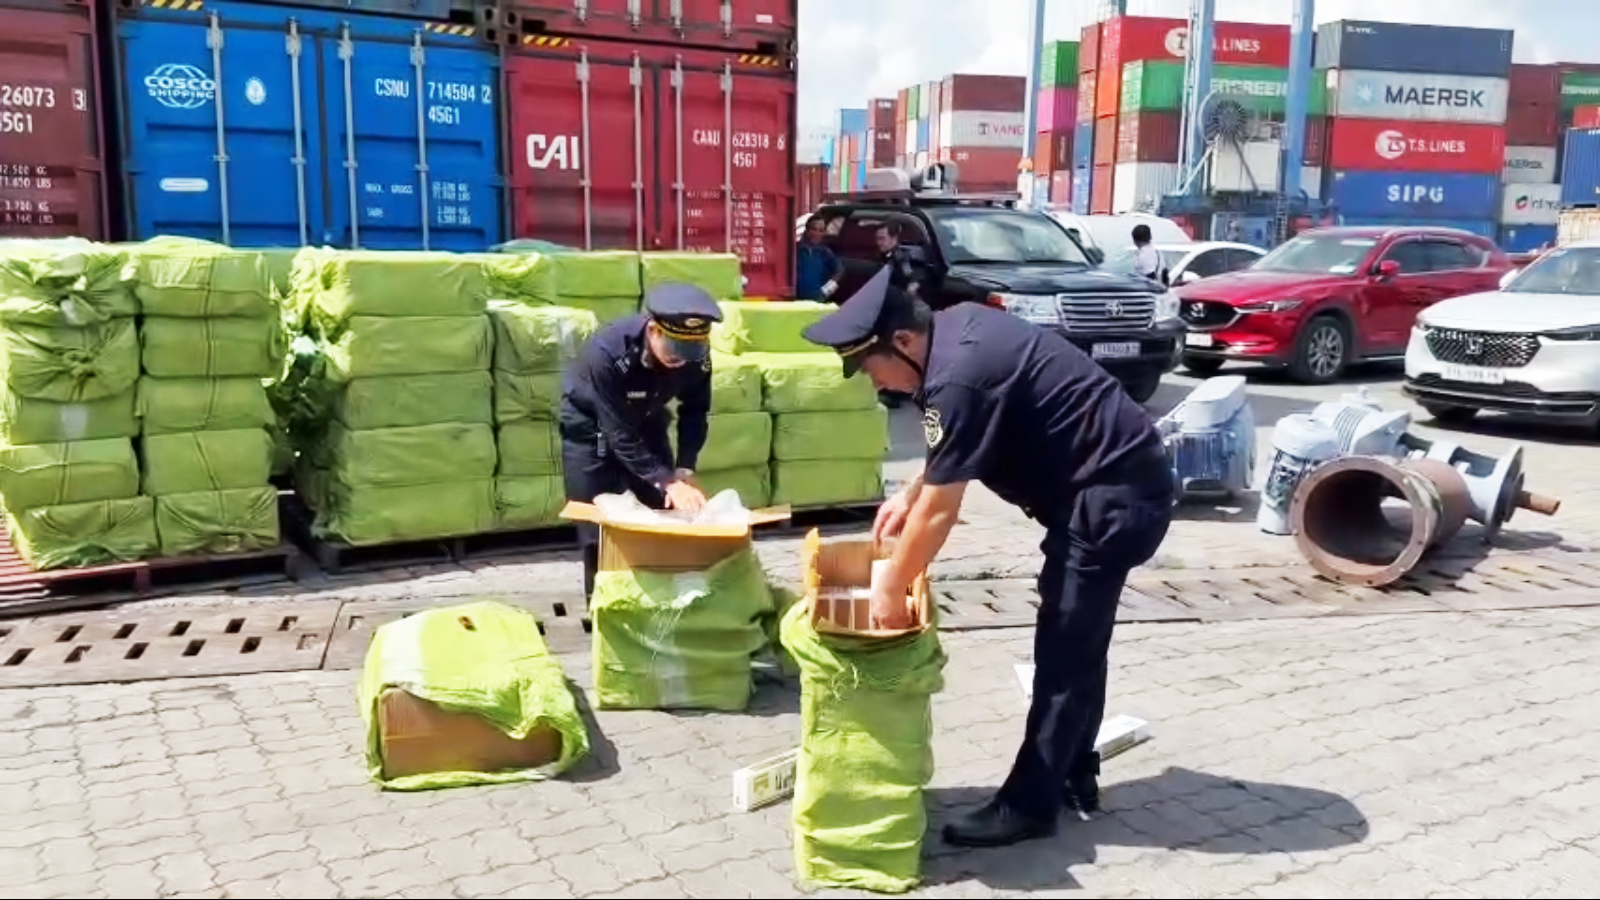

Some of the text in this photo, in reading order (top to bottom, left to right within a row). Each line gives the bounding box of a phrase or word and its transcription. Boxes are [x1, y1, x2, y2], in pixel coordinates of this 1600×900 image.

[1222, 38, 1261, 53] LINES
[144, 76, 216, 91] COSCO
[375, 78, 492, 104] CSNU 714594 2
[1210, 78, 1288, 97] ERGREEN
[73, 89, 85, 110] 3
[148, 89, 214, 99] SHIPPING
[1385, 84, 1486, 108] MAERSK
[428, 105, 460, 125] 45G1
[526, 133, 580, 170] CAI
[776, 135, 786, 150] 6
[1429, 139, 1466, 153] LINES
[732, 151, 757, 168] 45G1
[1387, 184, 1444, 203] SIPG
